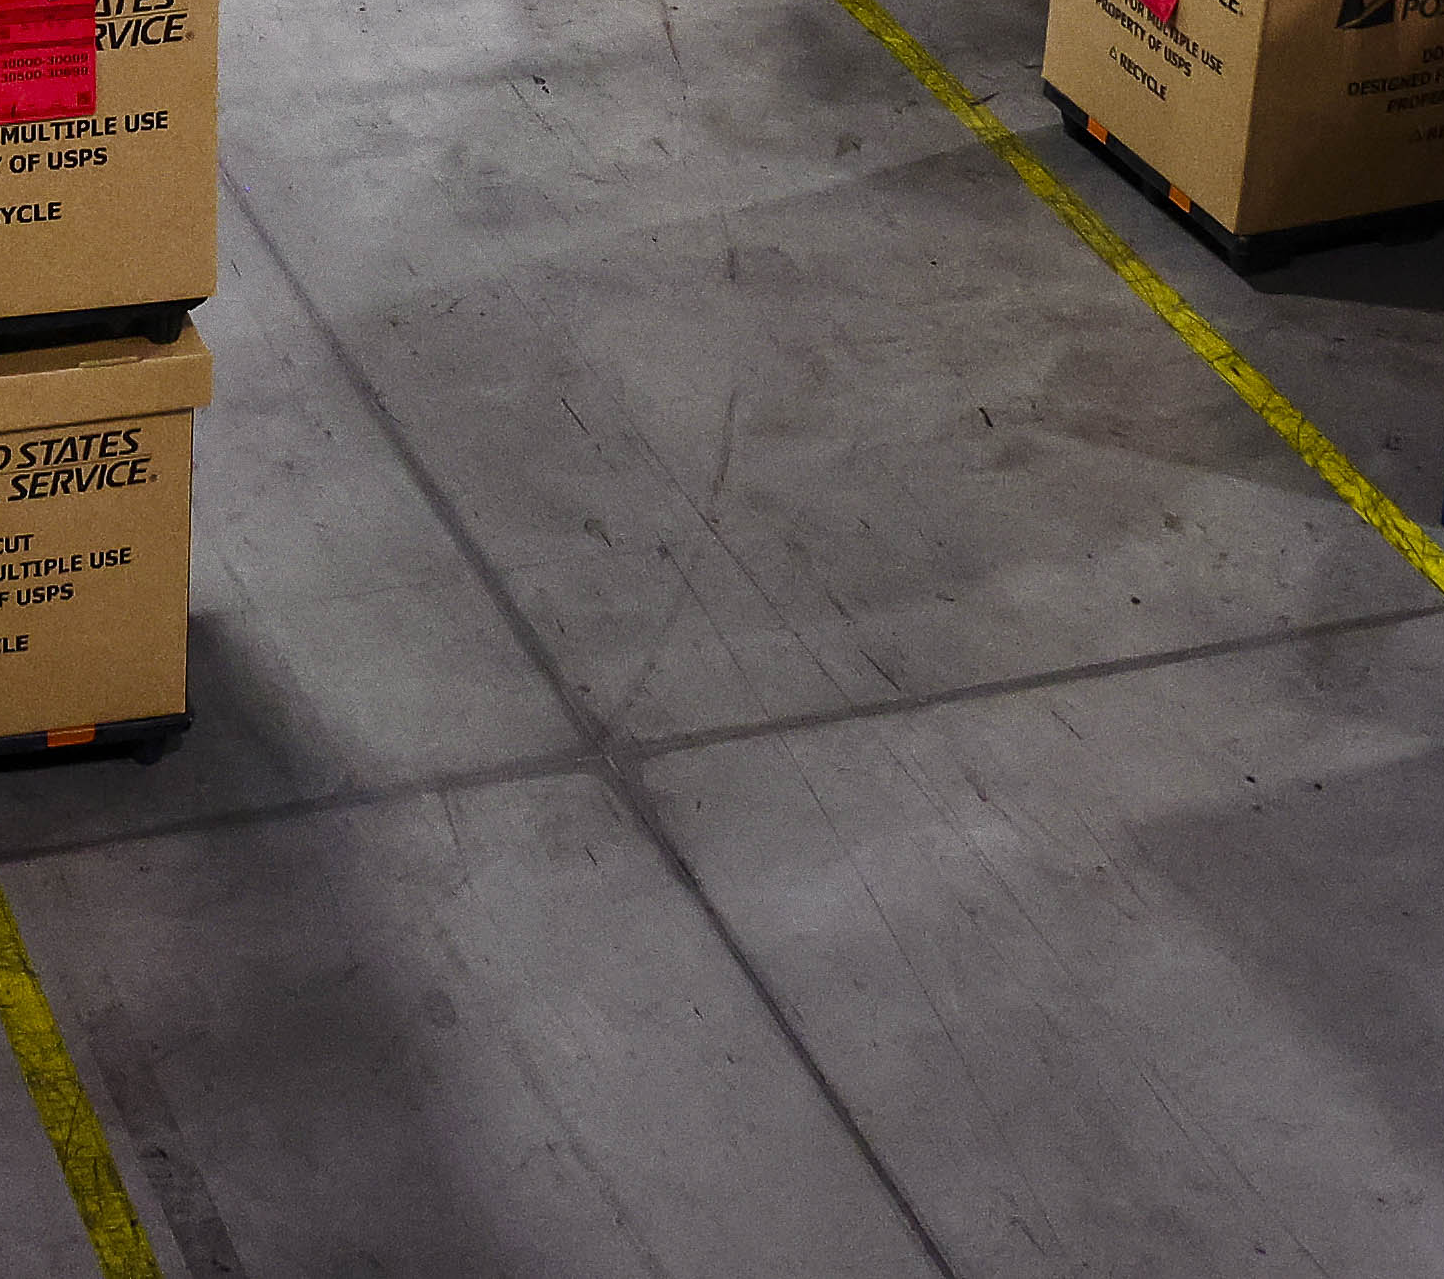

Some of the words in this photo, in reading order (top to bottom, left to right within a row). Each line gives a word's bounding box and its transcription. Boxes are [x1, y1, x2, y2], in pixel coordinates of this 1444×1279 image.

[95, 13, 188, 52] RVICE
[0, 115, 117, 146] MULTIPLE
[123, 111, 169, 134] USE
[8, 153, 39, 175] OF
[46, 147, 107, 171] USPS
